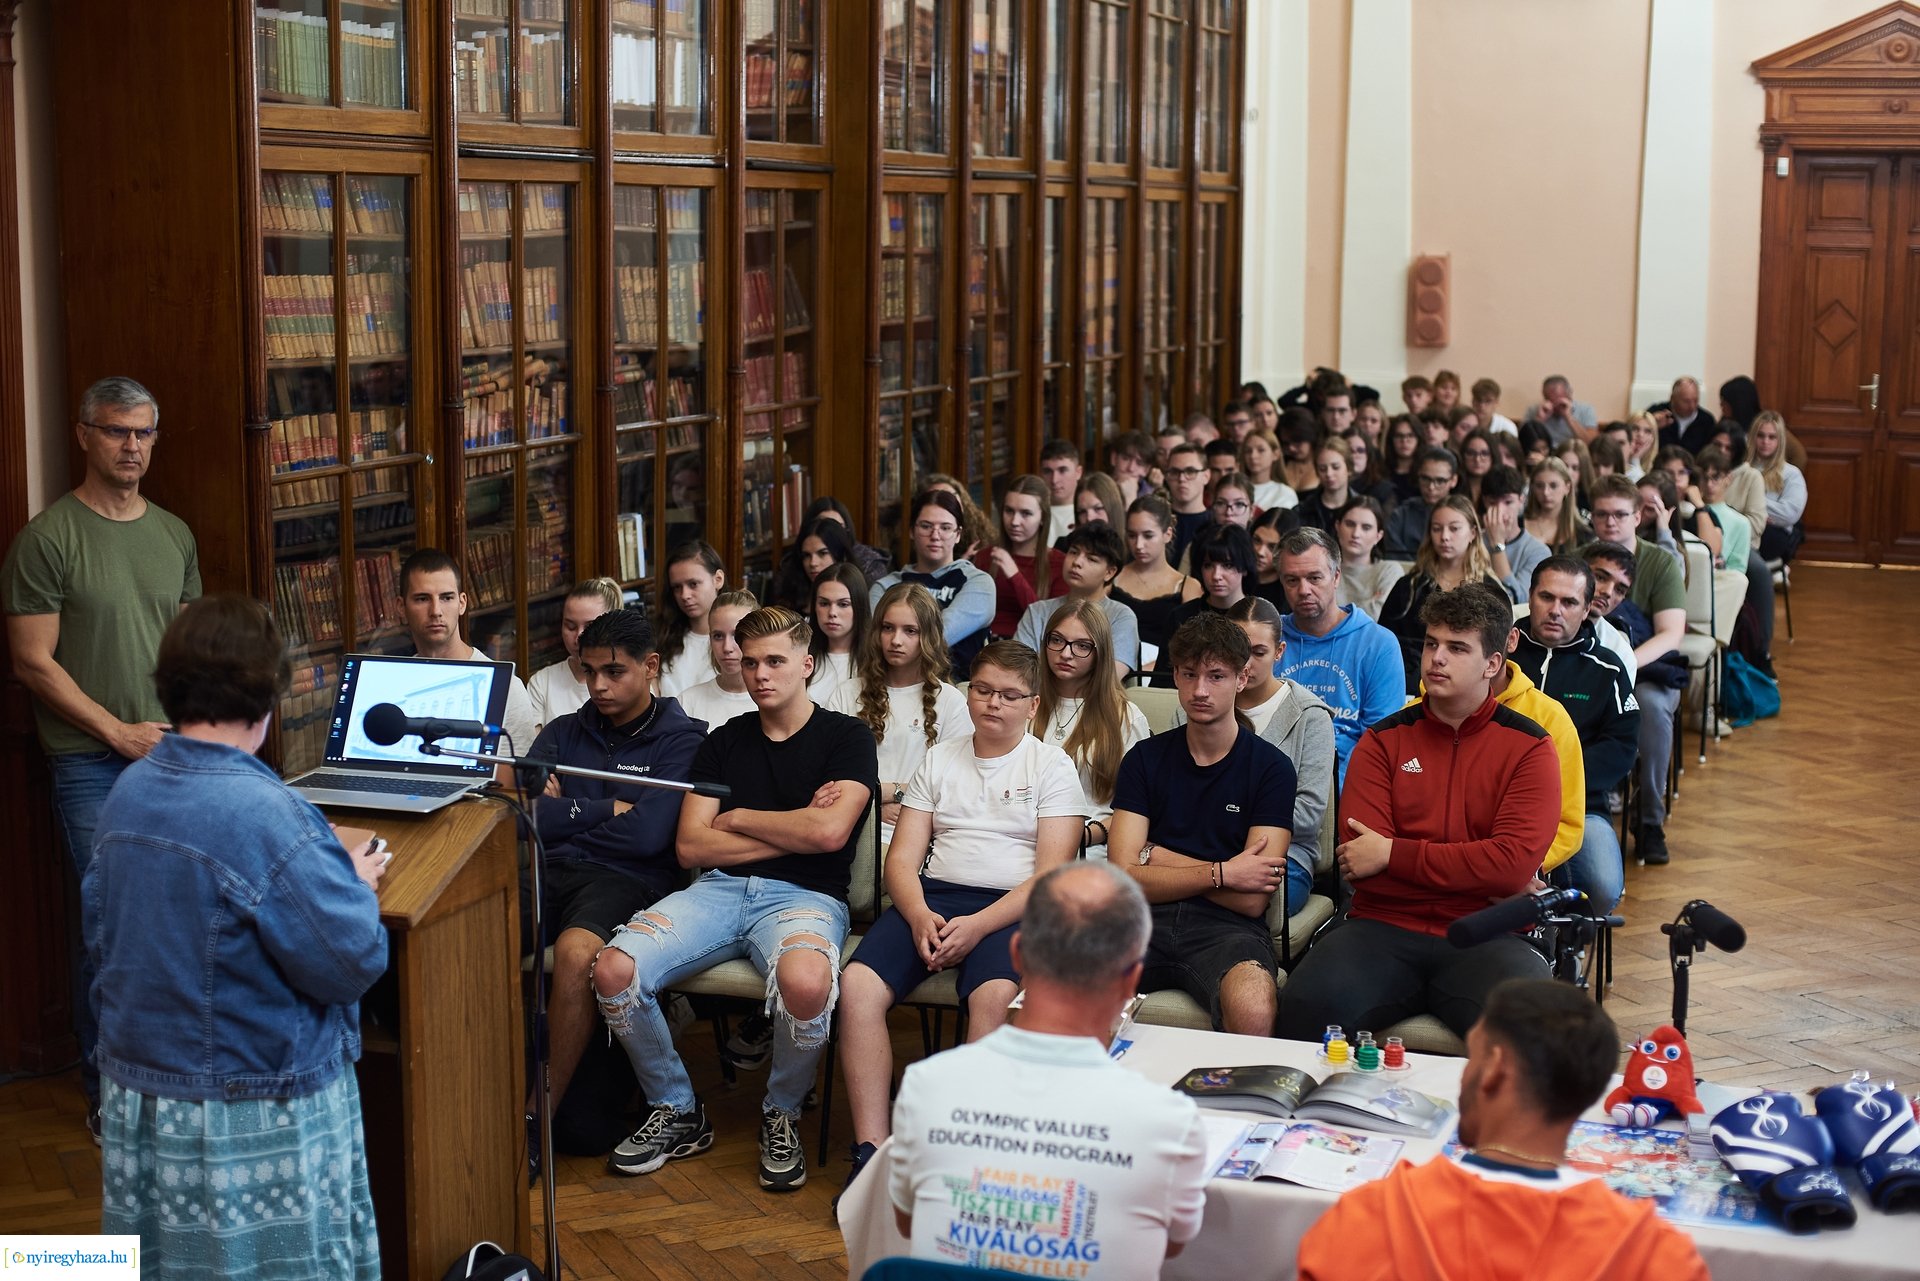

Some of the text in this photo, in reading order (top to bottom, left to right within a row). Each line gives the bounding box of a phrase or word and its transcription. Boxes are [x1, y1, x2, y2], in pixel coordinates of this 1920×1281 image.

[1332, 664, 1358, 701] CLOTHING
[616, 763, 644, 773] hooded
[1401, 764, 1423, 773] adidas
[951, 1107, 1111, 1142] OLYMPIC VALUES
[928, 1128, 1134, 1169] EDUCATION PROGRAM
[983, 1167, 1018, 1185] FAIR
[1022, 1172, 1063, 1191] PLAY
[952, 1189, 1058, 1224] TISZTELET
[980, 1182, 1061, 1207] KIVÁLÓSÁG
[960, 1211, 991, 1228] FAIR
[995, 1214, 1036, 1234] PLAY
[949, 1220, 1101, 1262] KIVÁLÓSÁG
[988, 1251, 1090, 1279] TISZTELET
